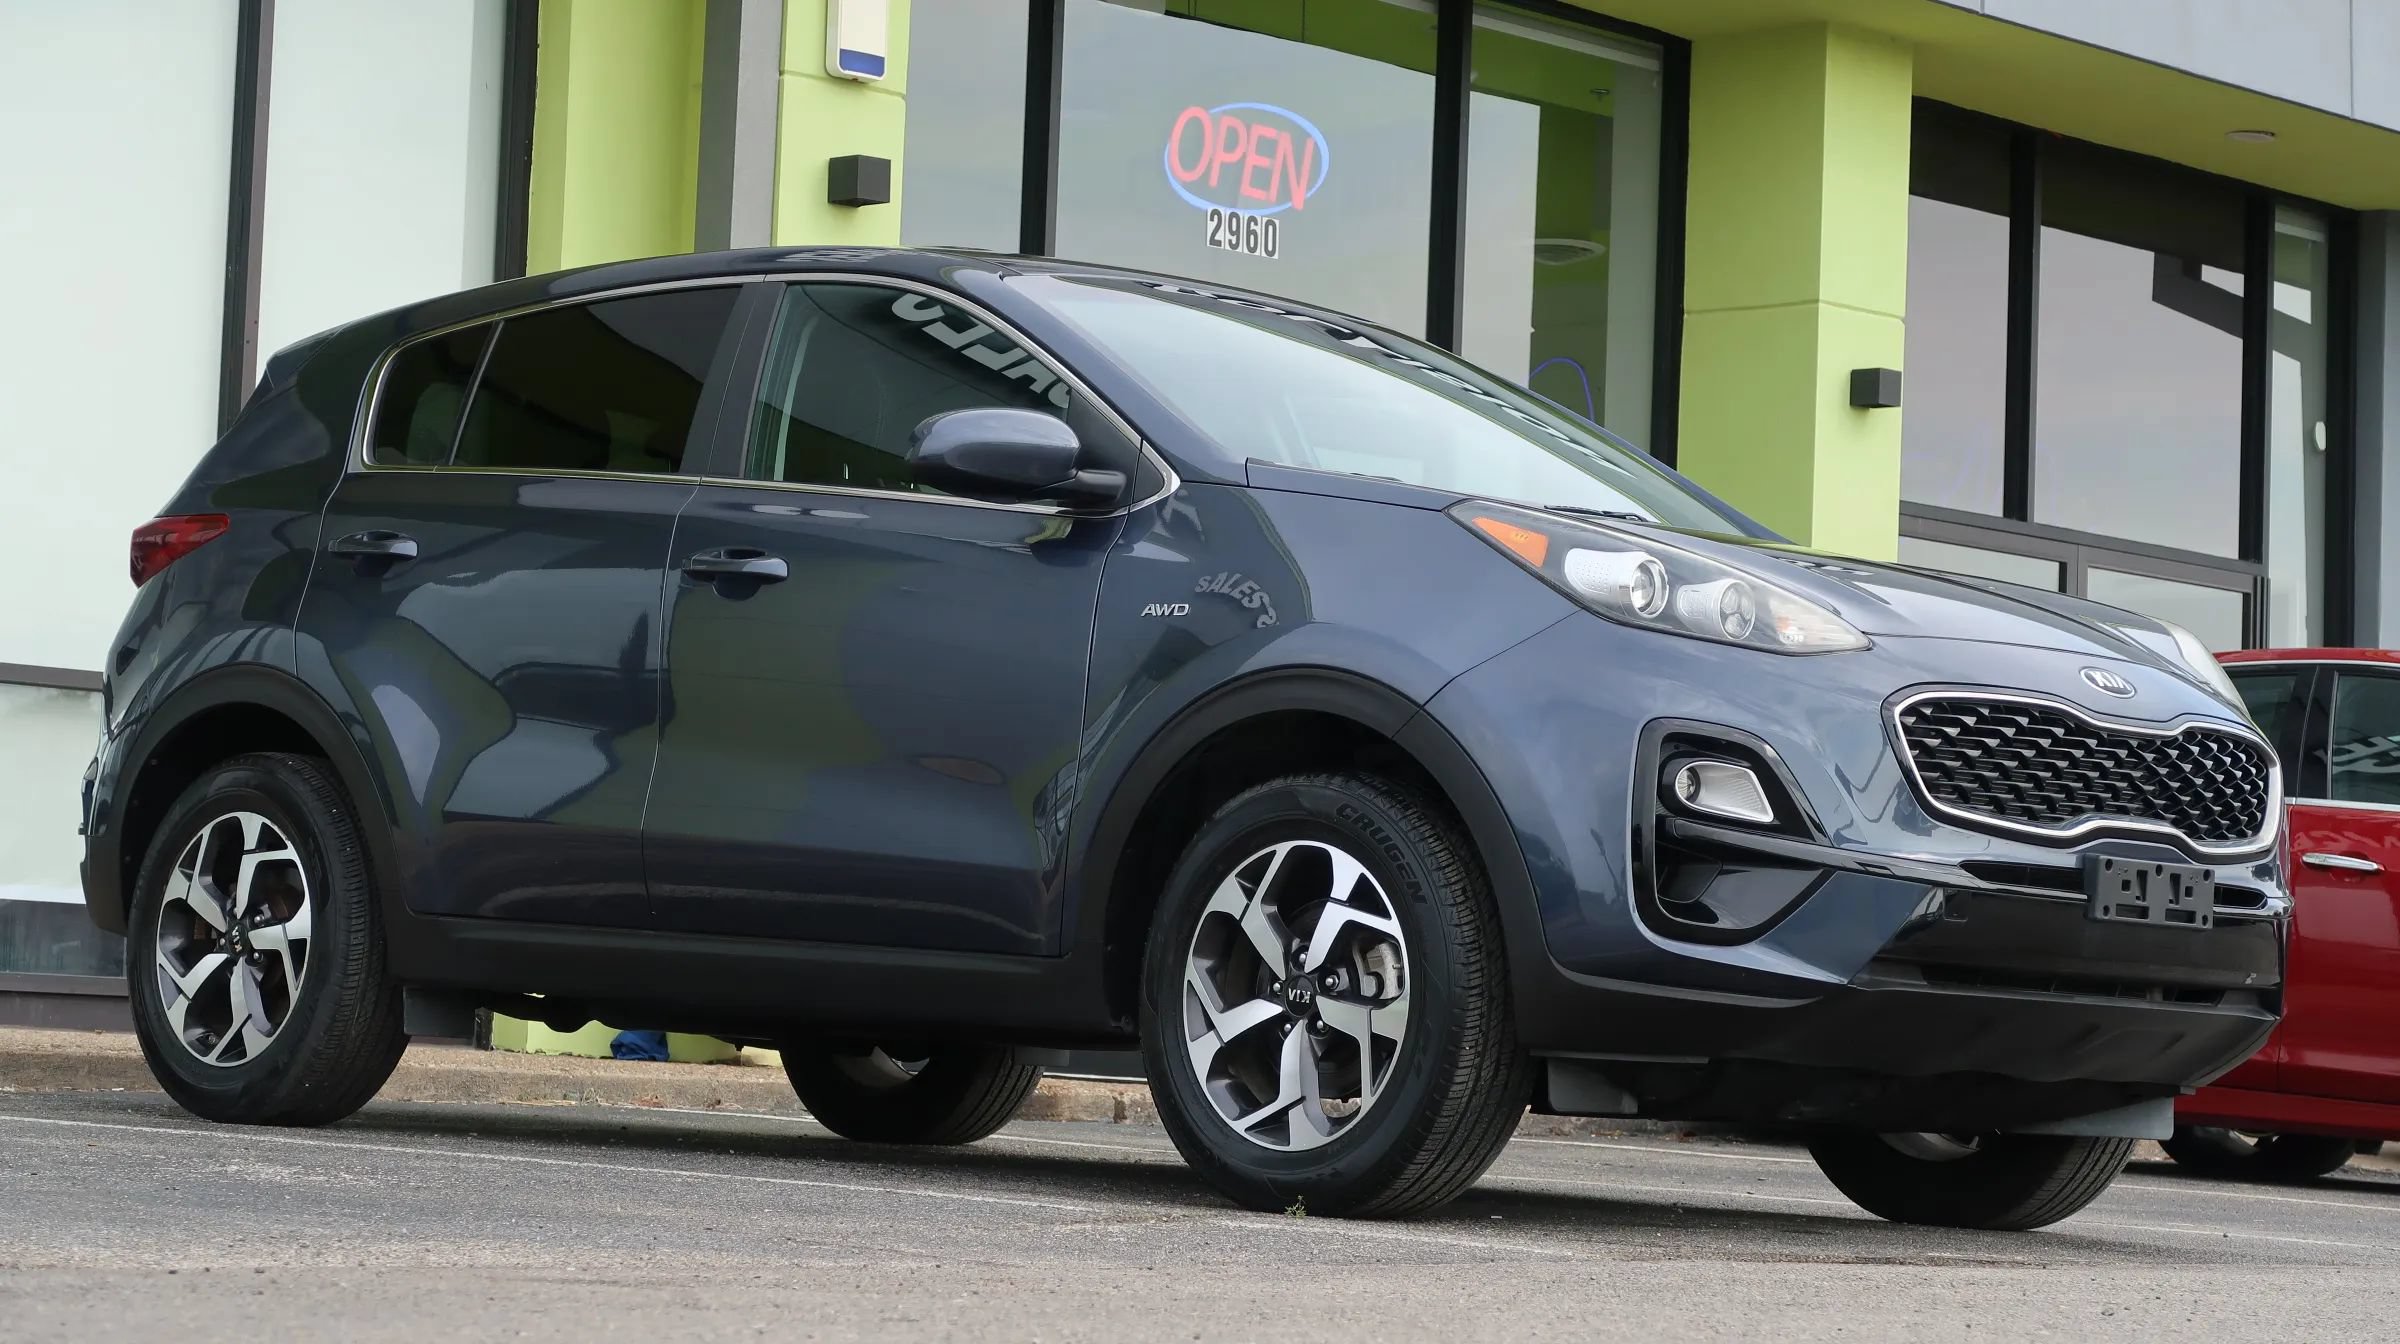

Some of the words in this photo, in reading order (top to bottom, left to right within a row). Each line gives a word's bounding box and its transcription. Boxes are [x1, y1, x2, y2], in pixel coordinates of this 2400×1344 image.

[1168, 105, 1315, 212] OPEN
[1208, 208, 1278, 258] 2960
[1140, 603, 1191, 617] AWD
[2087, 670, 2131, 690] KIA
[1335, 802, 1429, 905] CRUGEN
[1287, 986, 1312, 1004] KIA
